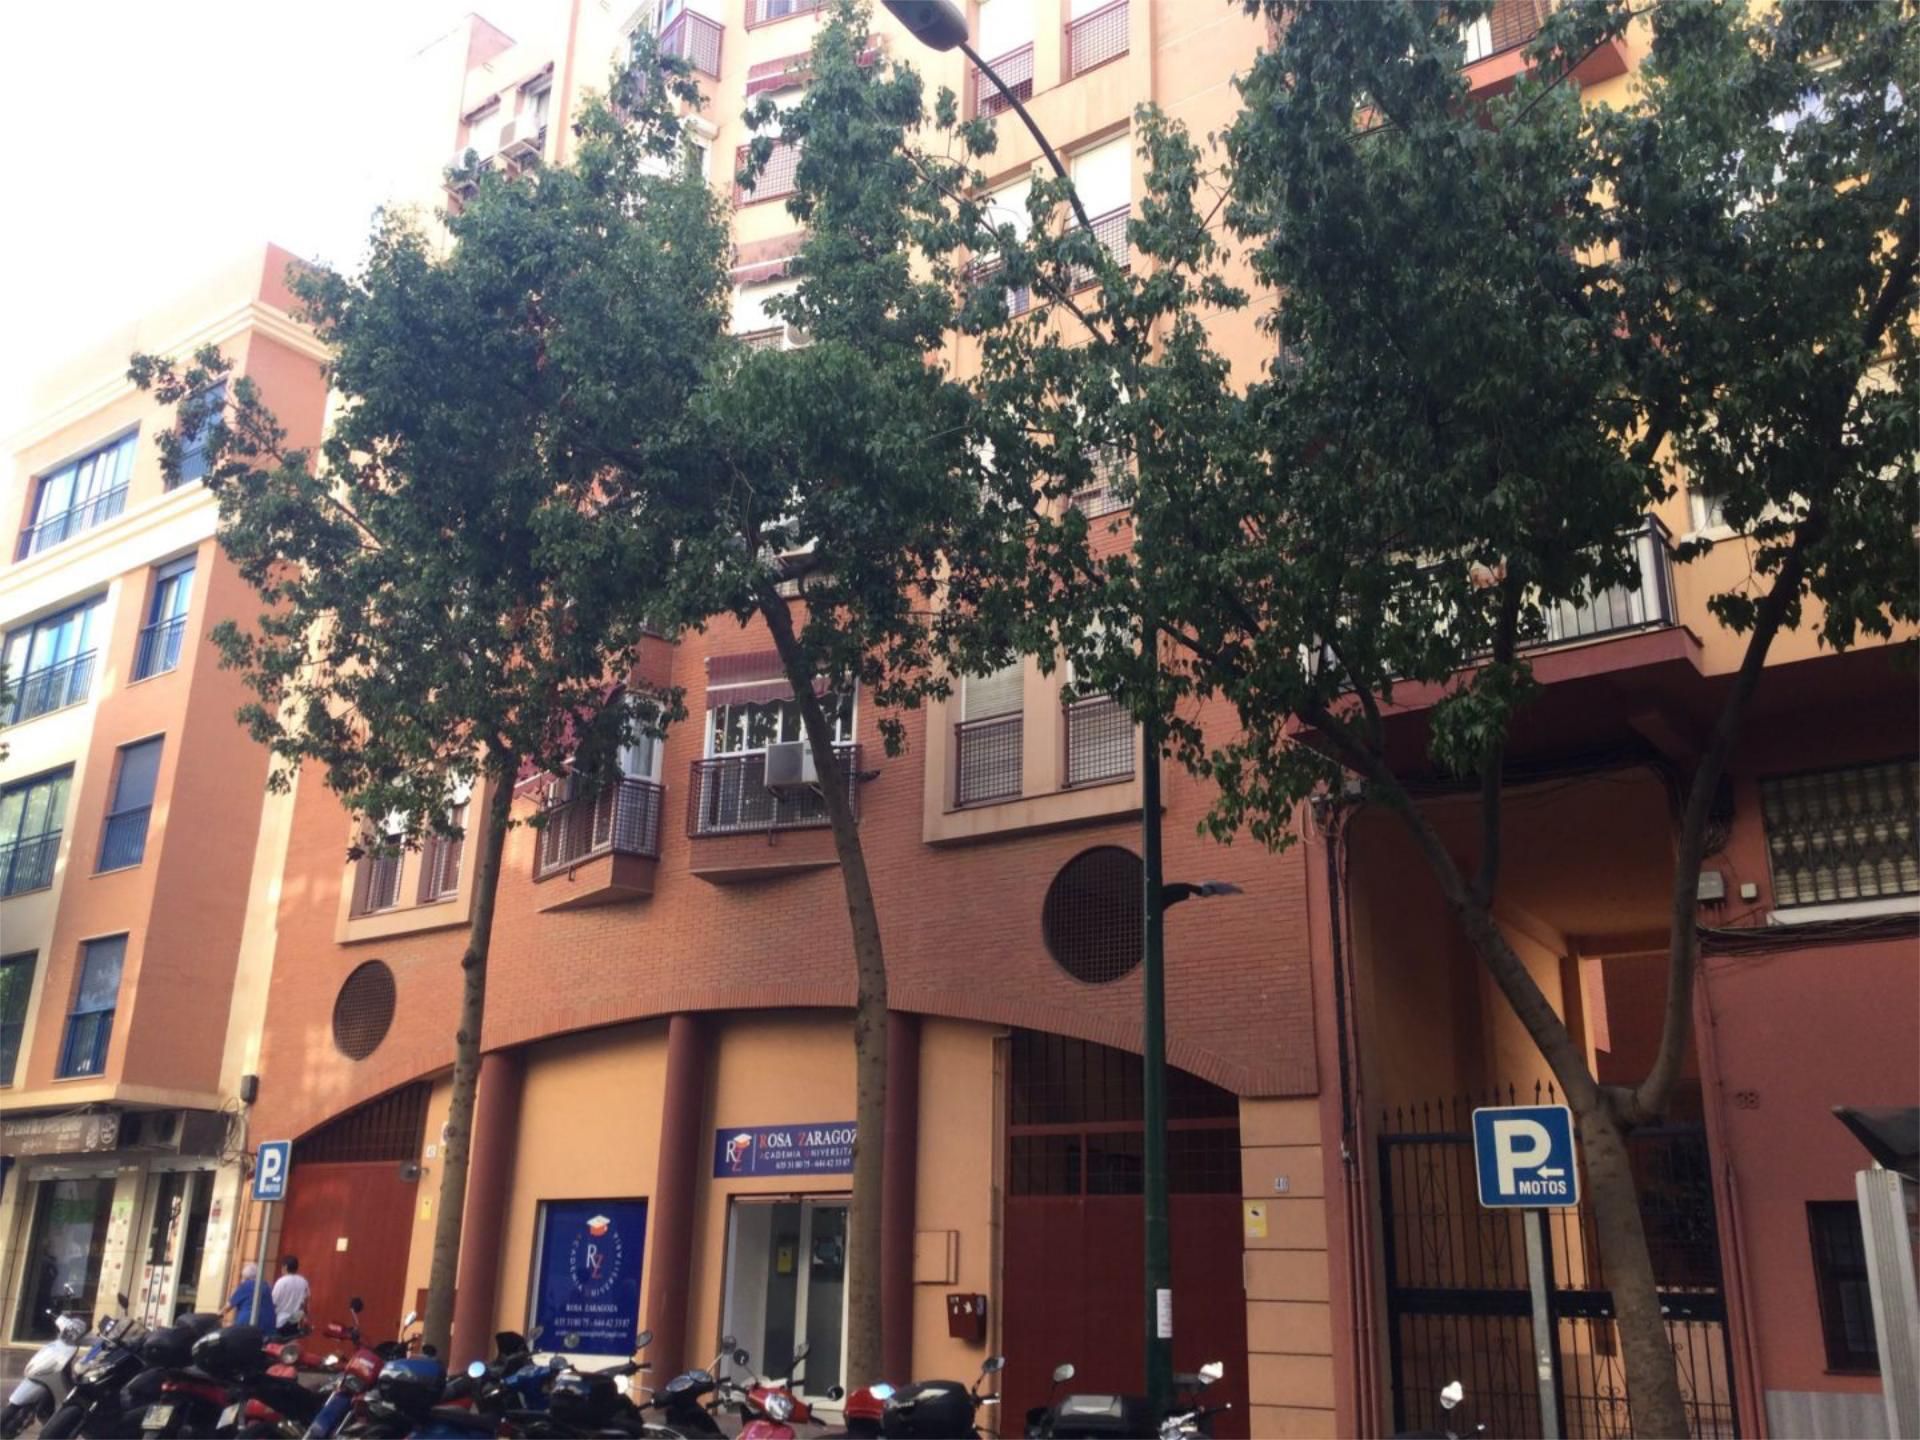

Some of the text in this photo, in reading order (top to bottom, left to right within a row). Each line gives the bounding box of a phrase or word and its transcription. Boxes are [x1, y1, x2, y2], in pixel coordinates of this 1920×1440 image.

[759, 1132, 792, 1149] ROSA
[259, 1148, 281, 1193] P
[1493, 1119, 1552, 1195] P
[1519, 1181, 1567, 1195] MOTOS
